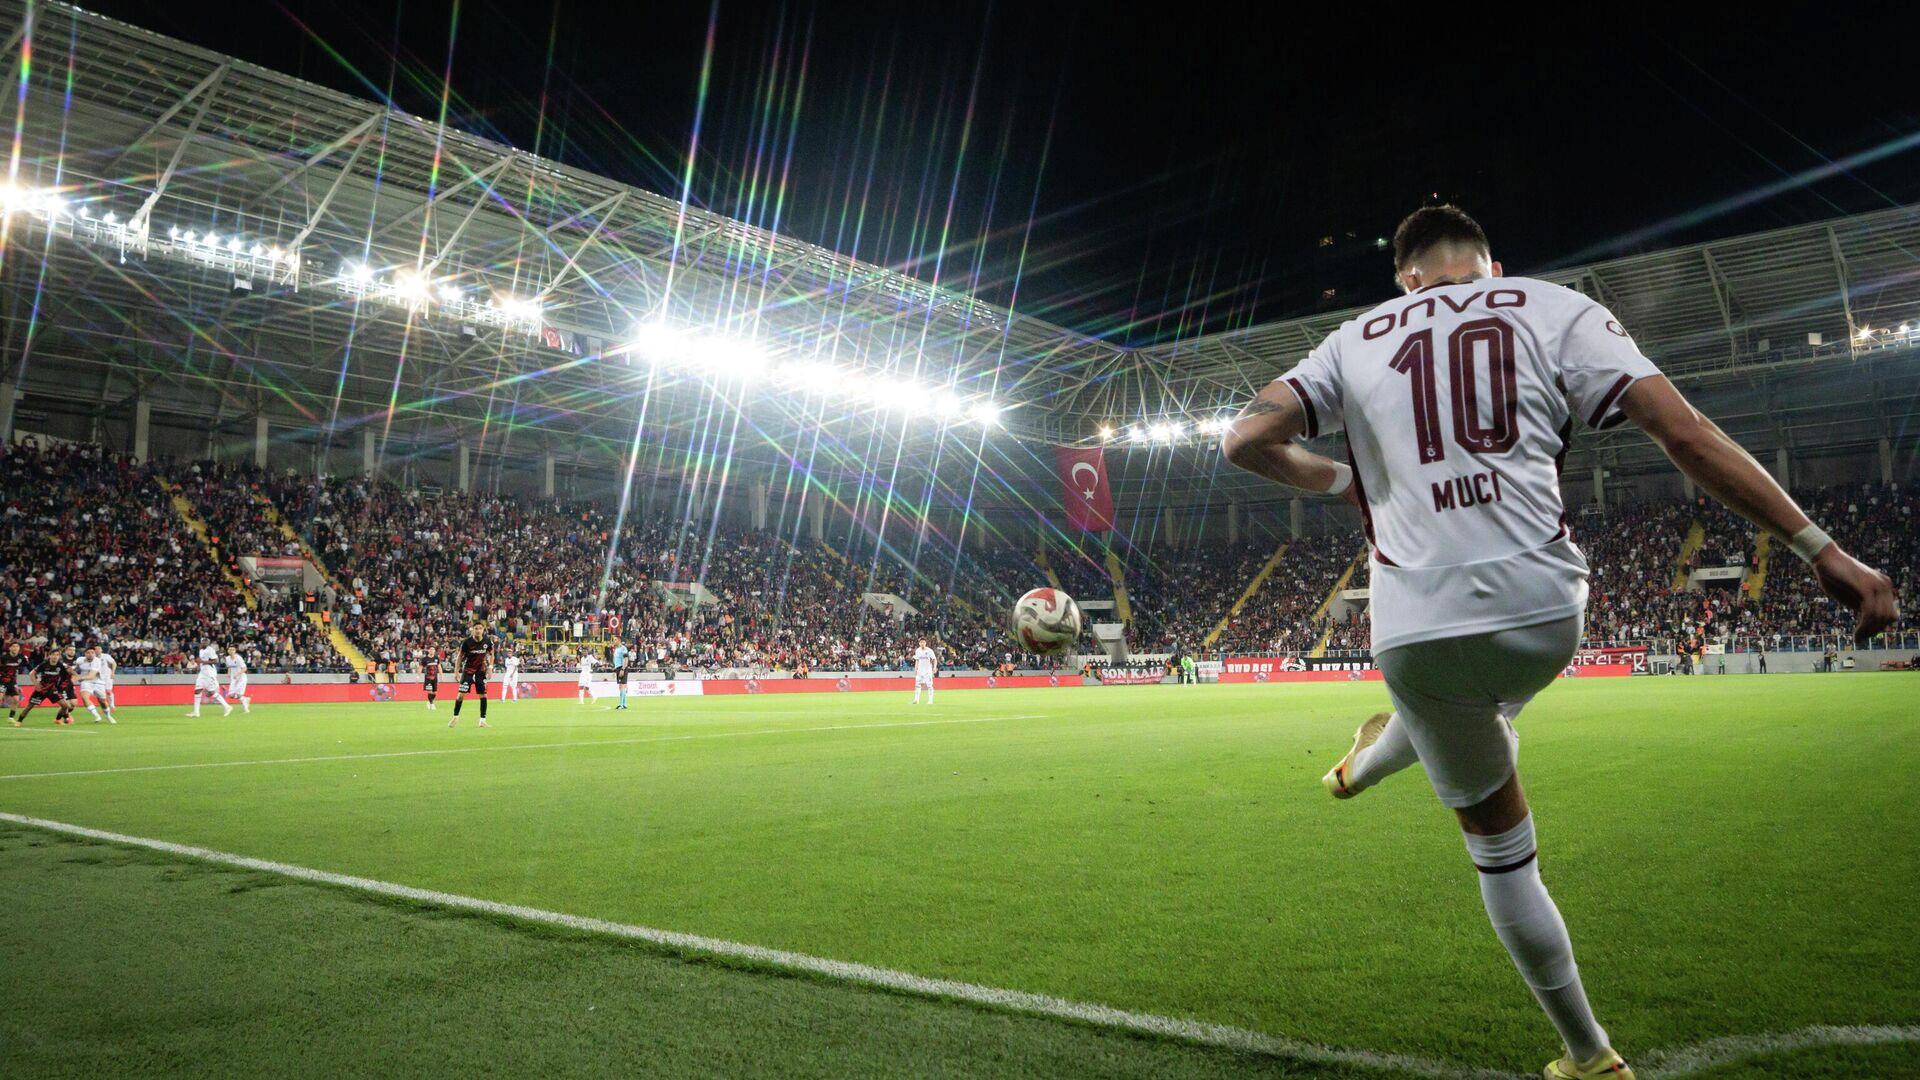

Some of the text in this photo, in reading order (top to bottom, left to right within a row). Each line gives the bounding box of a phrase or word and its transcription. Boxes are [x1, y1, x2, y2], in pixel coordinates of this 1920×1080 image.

[1362, 289, 1526, 340] onvo
[1388, 317, 1520, 465] 10
[1431, 470, 1502, 512] MUCI
[1101, 668, 1127, 679] SON
